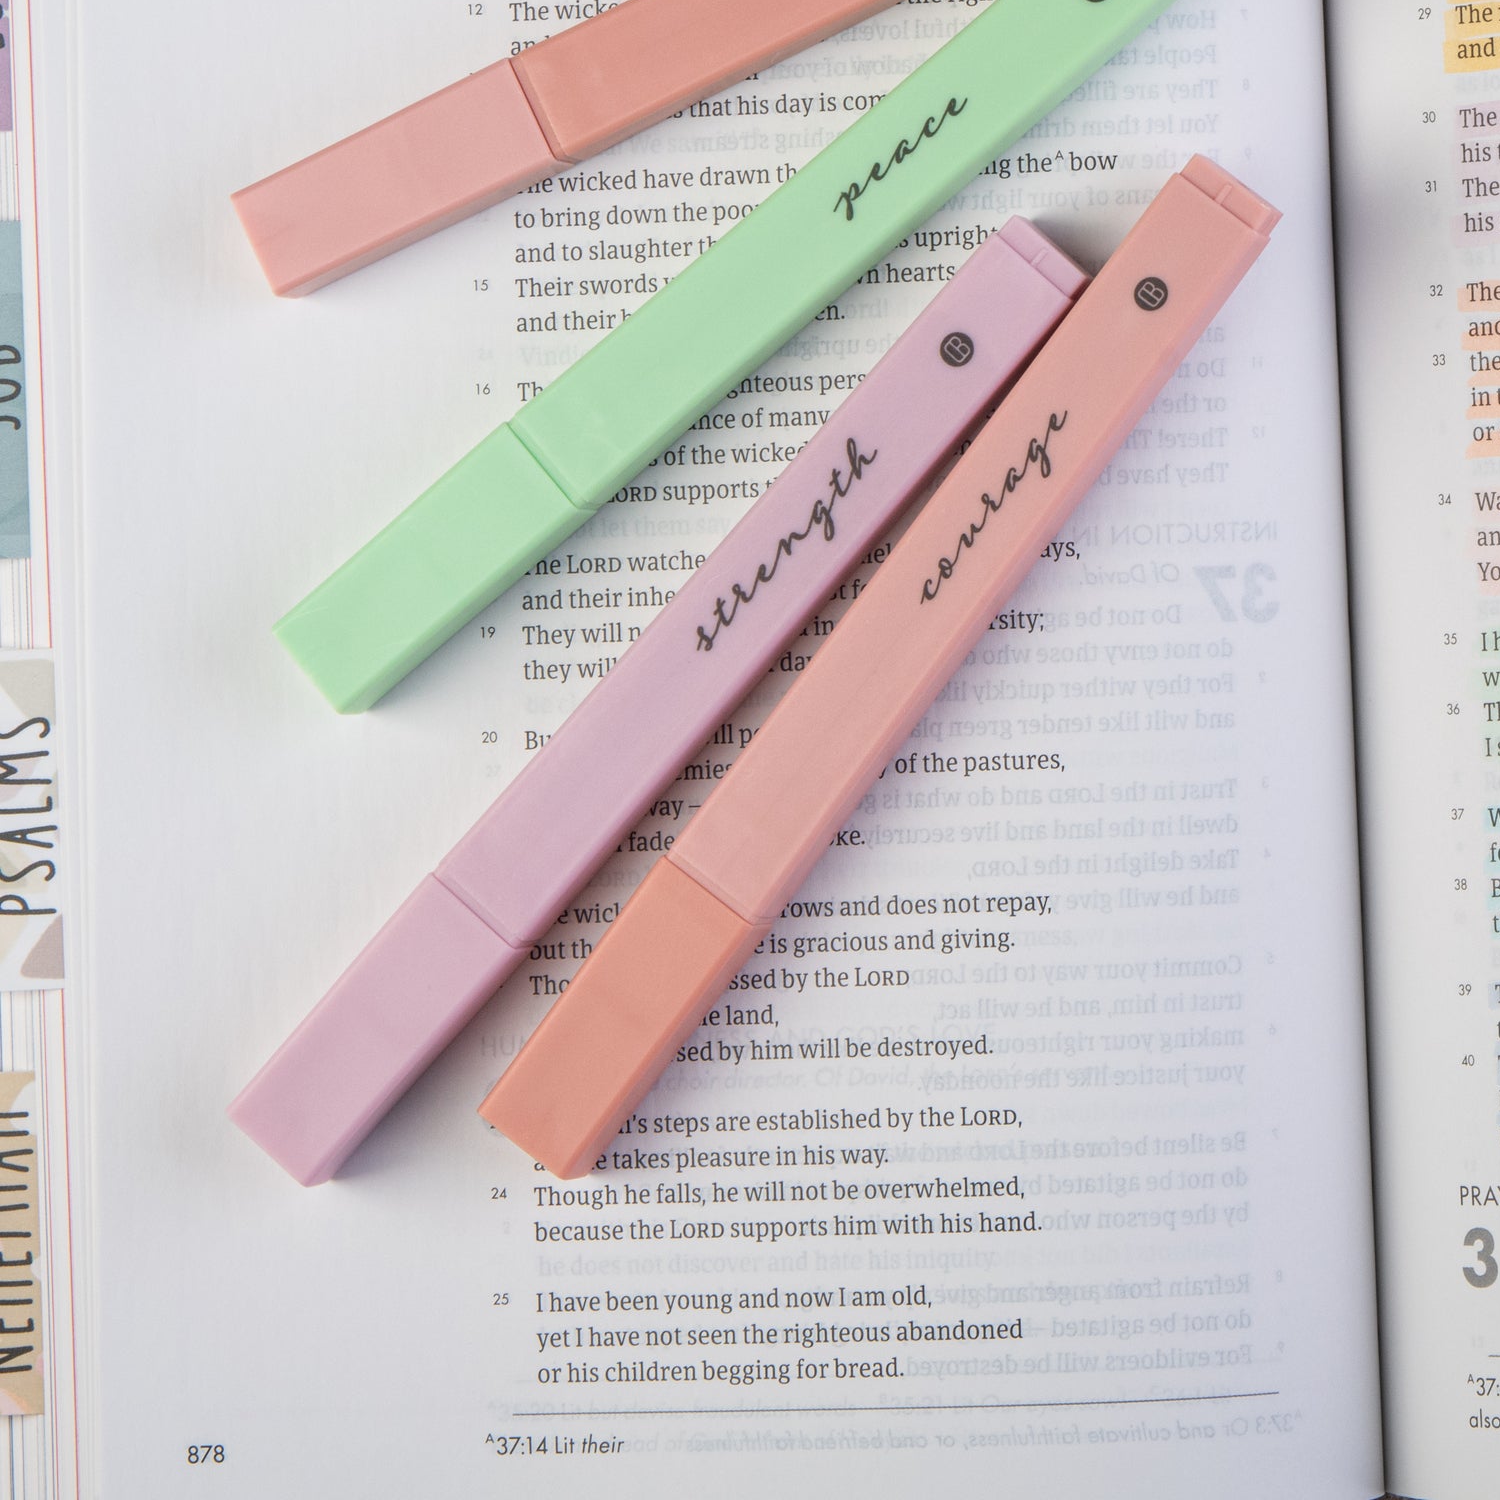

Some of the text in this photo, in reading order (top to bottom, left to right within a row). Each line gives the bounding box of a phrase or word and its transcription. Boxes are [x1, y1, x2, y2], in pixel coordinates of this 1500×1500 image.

[1422, 110, 1436, 124] 30
[1458, 107, 1498, 129] The
[833, 95, 968, 222] peace
[1429, 284, 1443, 297] 32
[918, 407, 1070, 605] courage
[1438, 493, 1452, 506] 34
[694, 436, 880, 655] strength
[1443, 632, 1458, 646] 35
[1480, 632, 1488, 652] I
[894, 751, 1065, 777] of the pastures,
[0, 717, 58, 915] PSALMS
[1454, 878, 1468, 891] 38
[493, 1284, 932, 1315] 25 I have been young and now I am old,
[187, 1444, 225, 1465] 878
[555, 1435, 575, 1455] Lit
[581, 1433, 625, 1454] their
